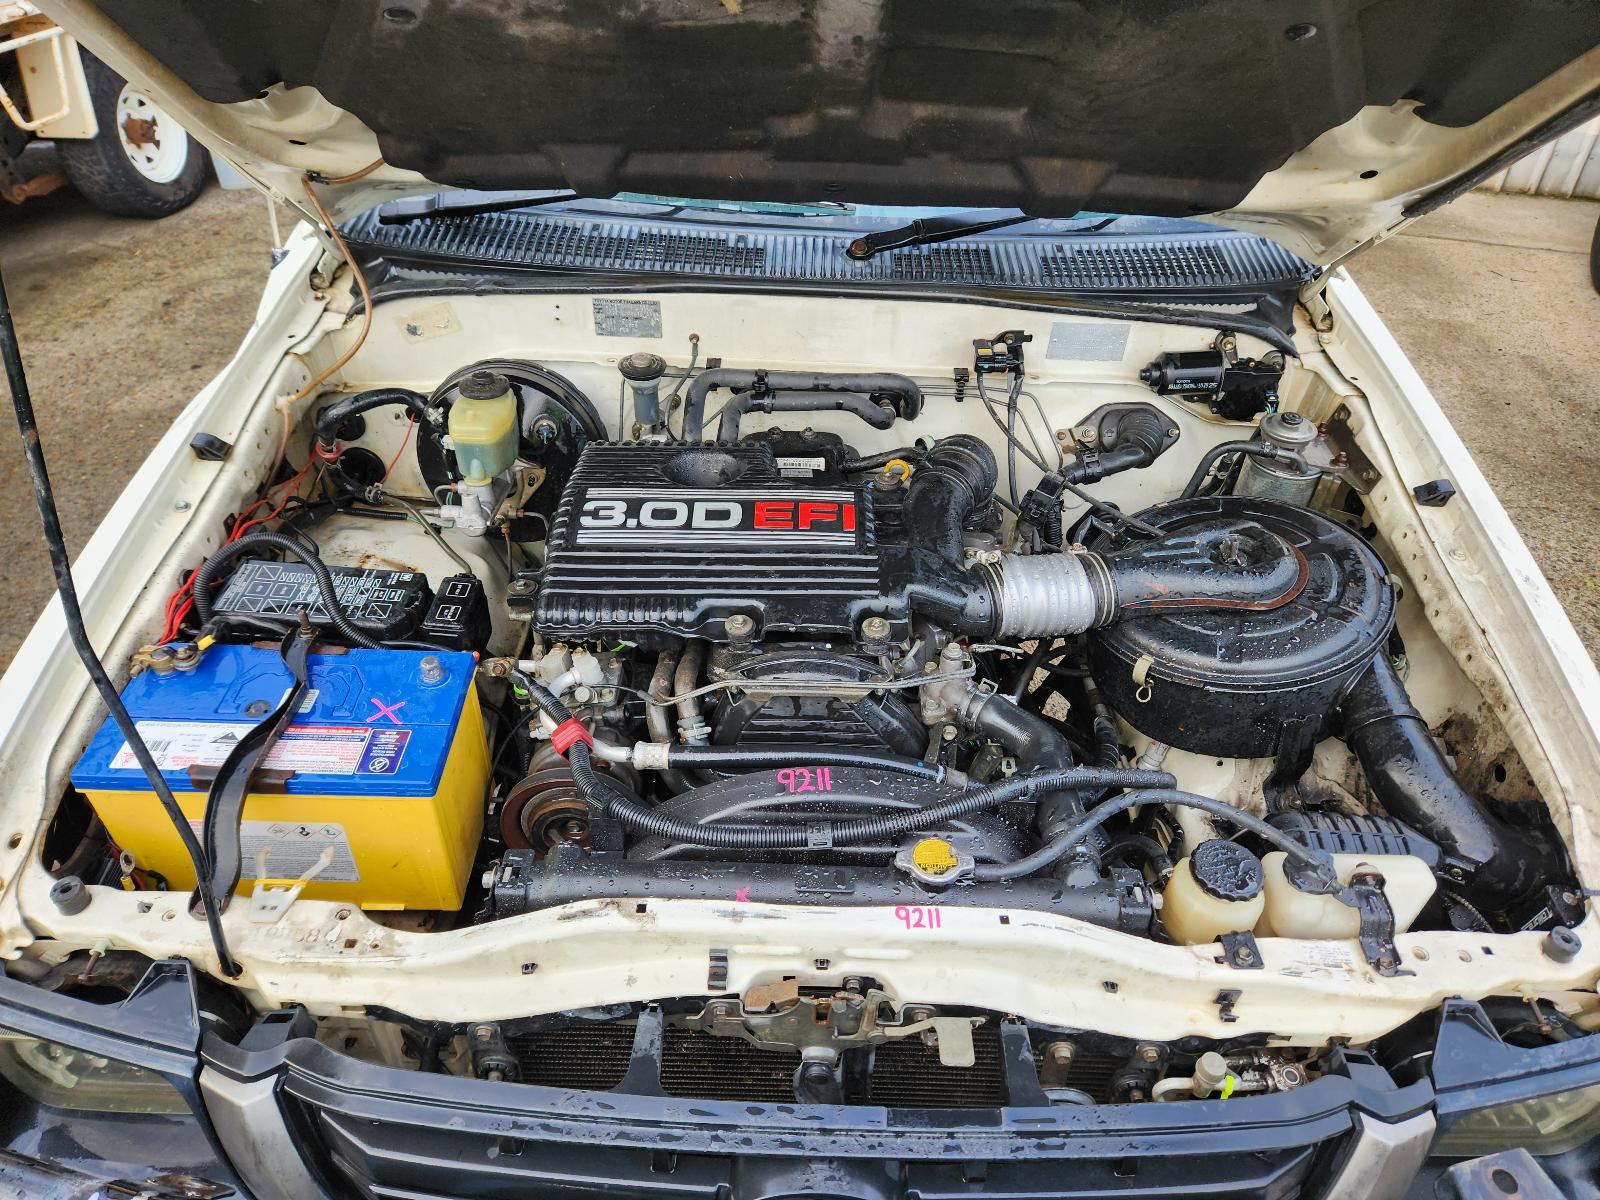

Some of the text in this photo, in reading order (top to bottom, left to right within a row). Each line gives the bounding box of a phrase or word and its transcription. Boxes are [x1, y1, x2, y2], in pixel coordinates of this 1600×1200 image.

[579, 500, 857, 532] 3.0D EFI
[777, 767, 832, 793] 9211
[894, 905, 942, 930] 9211
